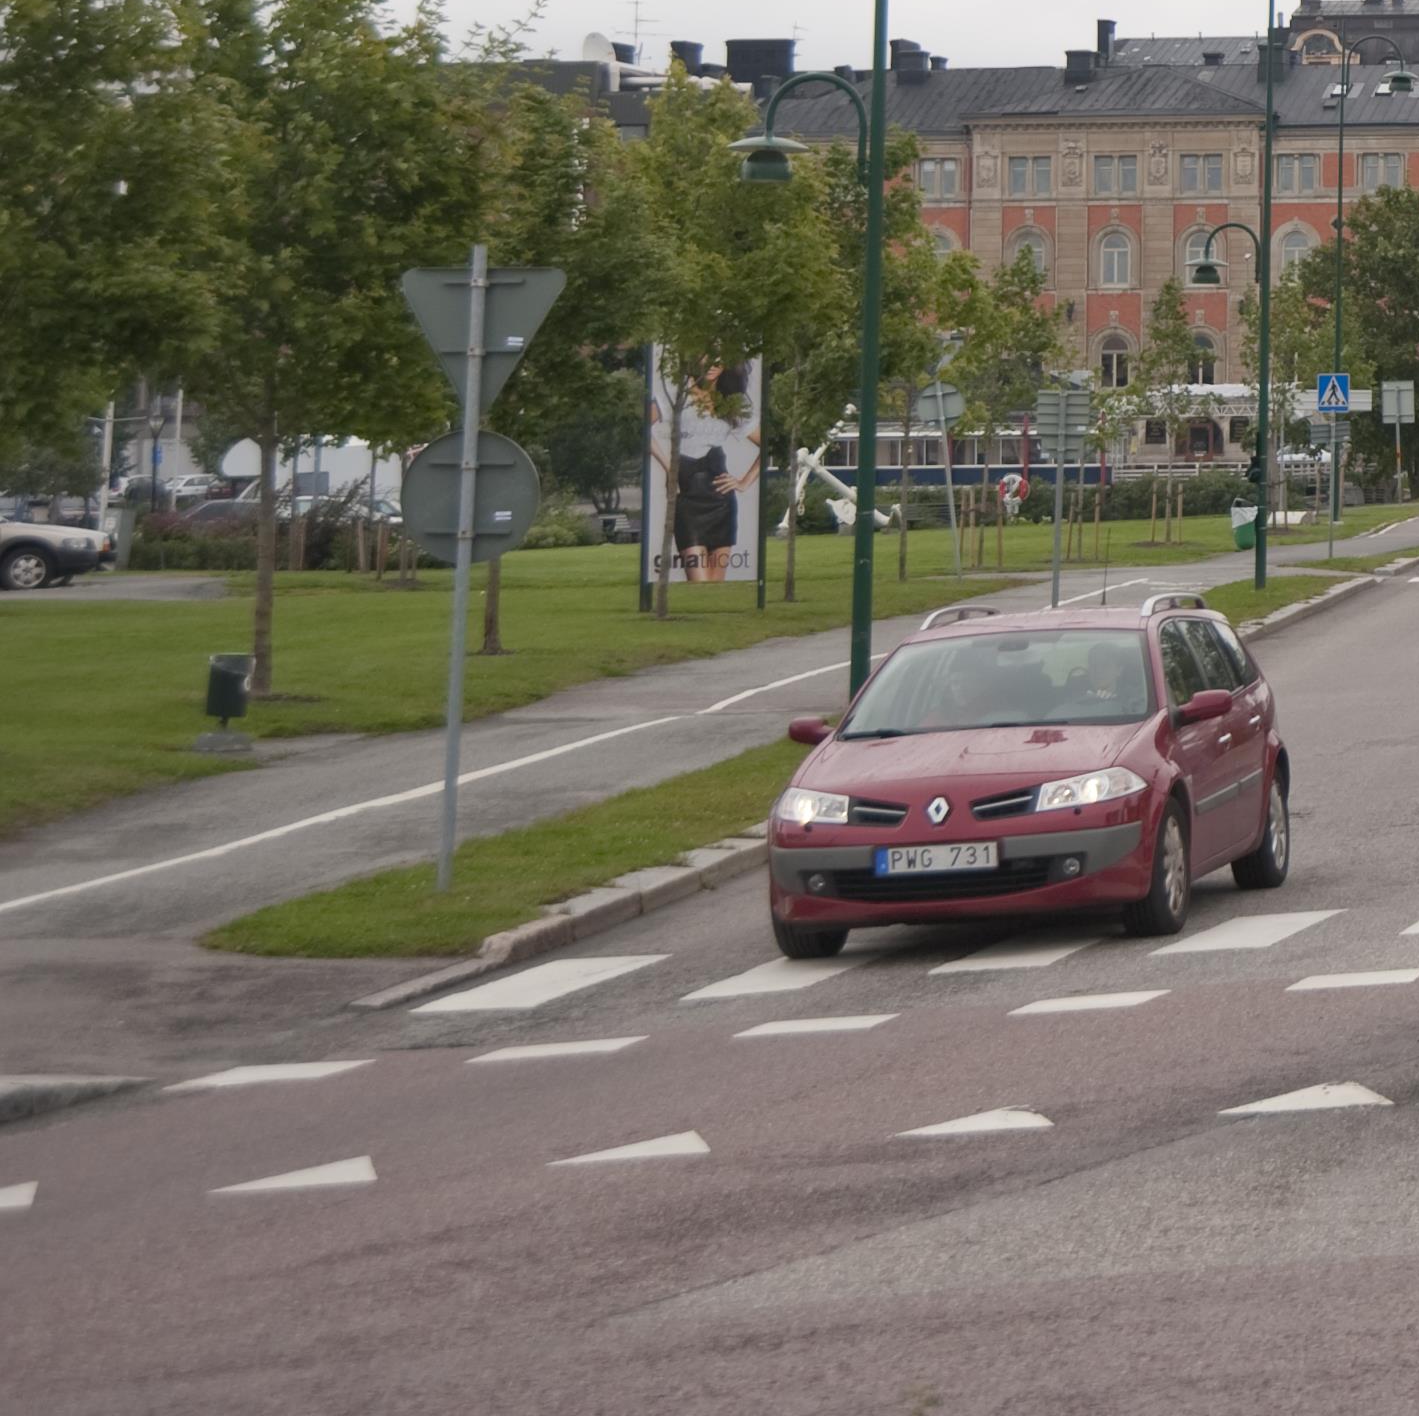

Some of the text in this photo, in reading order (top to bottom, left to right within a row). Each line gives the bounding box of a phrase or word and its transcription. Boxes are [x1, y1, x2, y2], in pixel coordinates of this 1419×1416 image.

[654, 549, 750, 574] gnatricot
[890, 845, 990, 870] PWG 731
